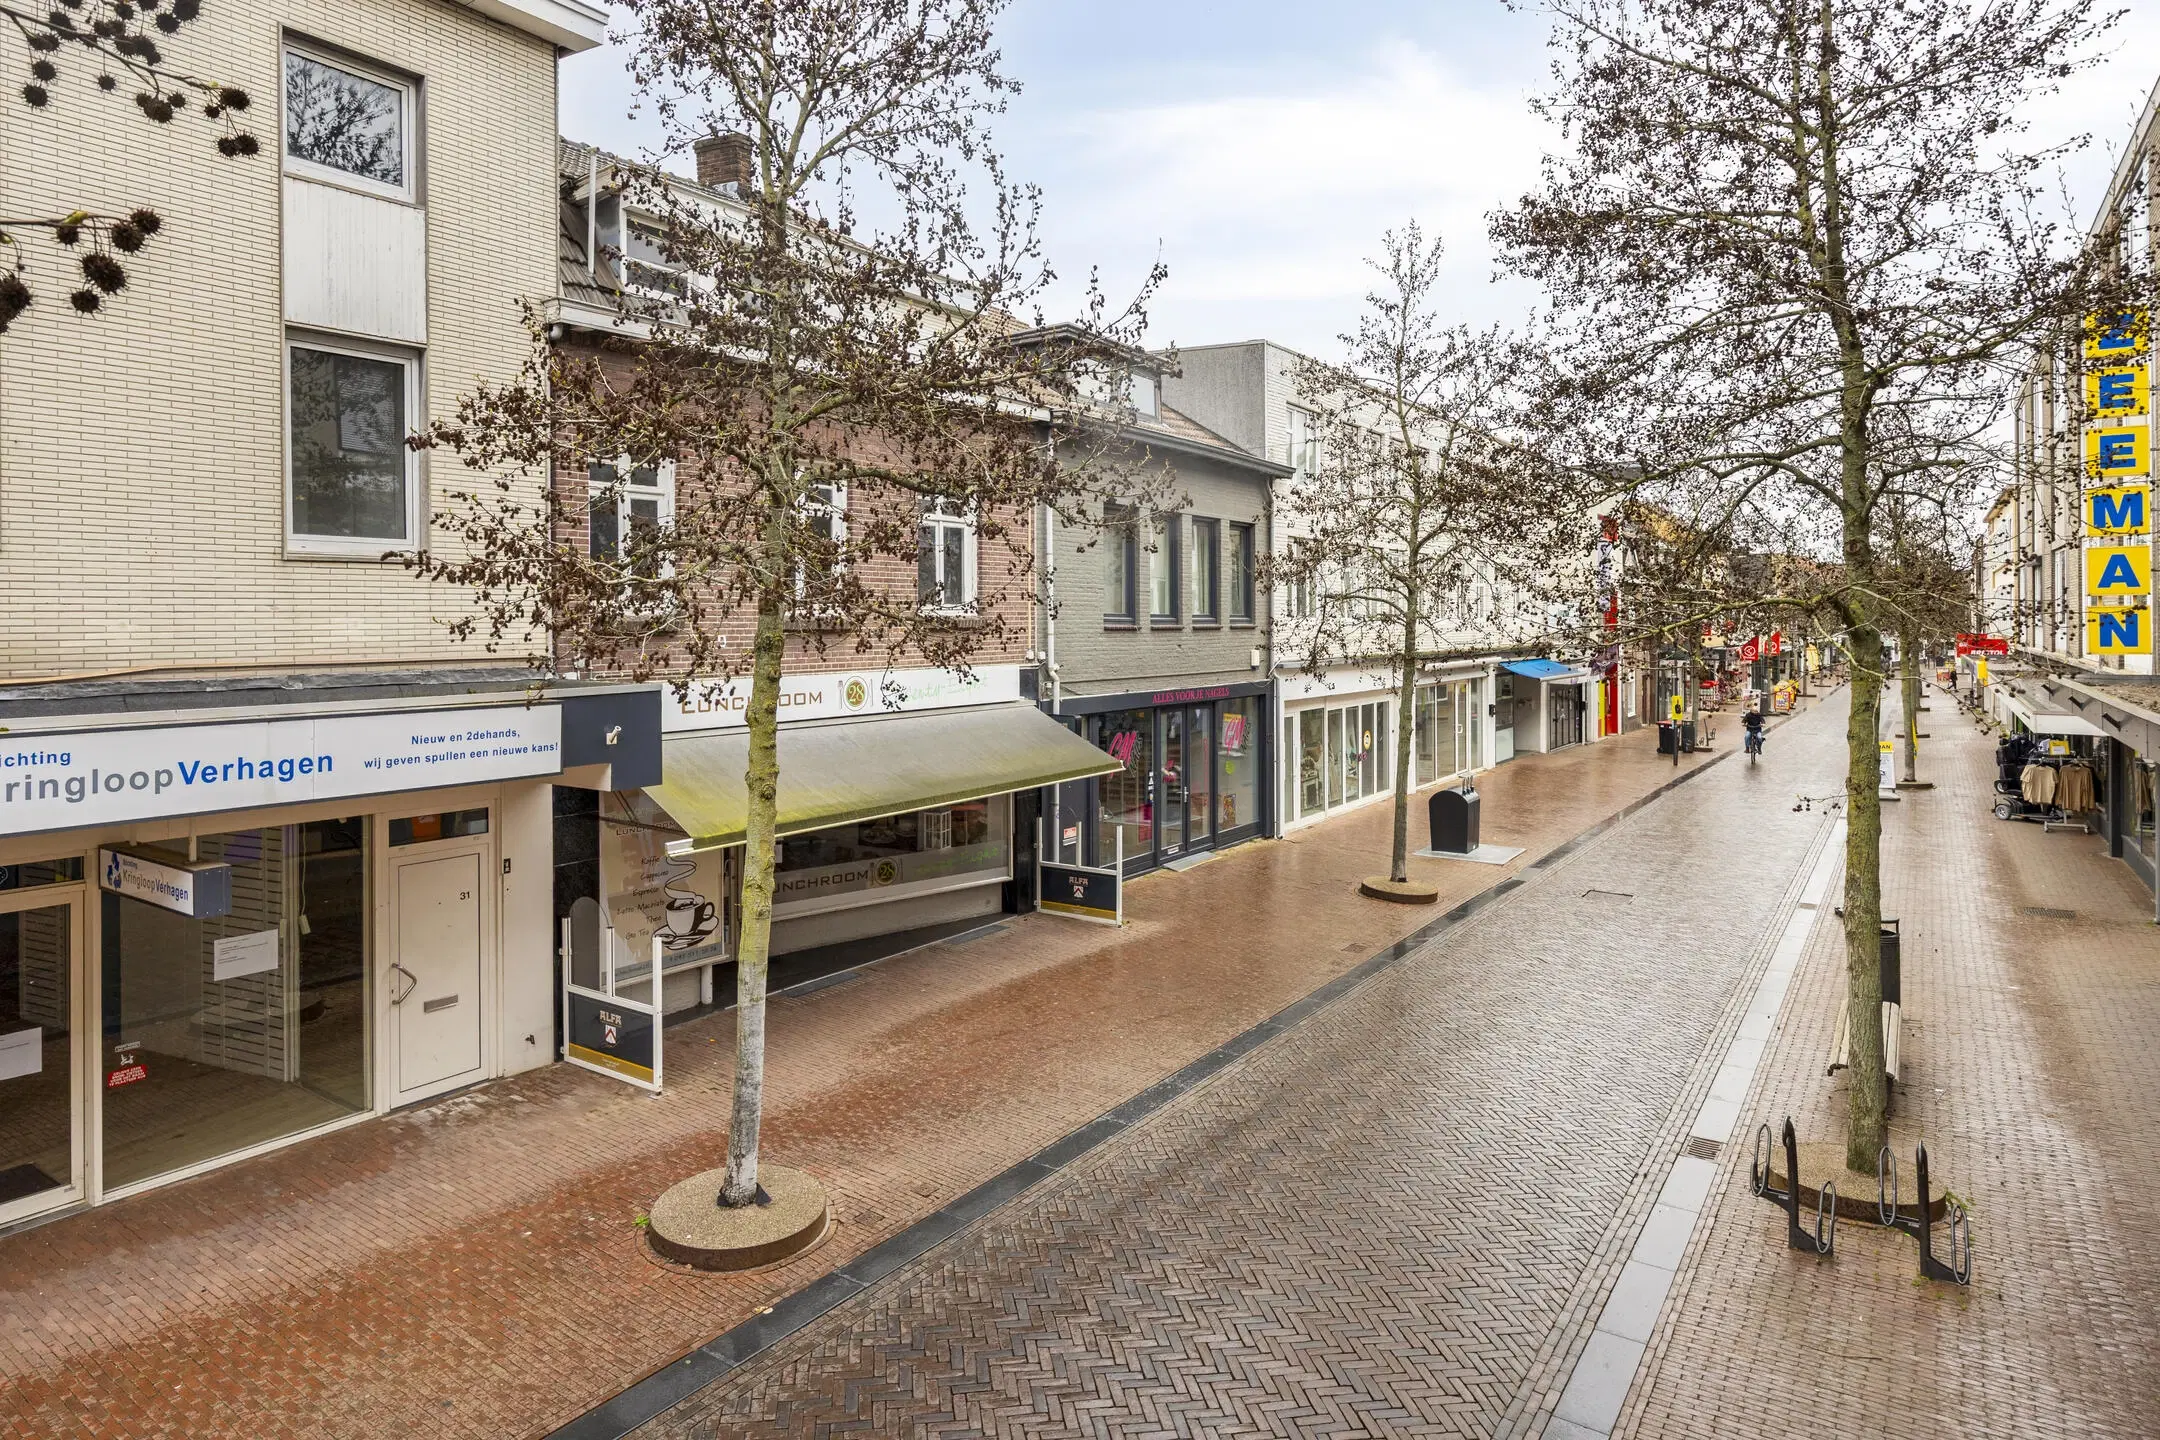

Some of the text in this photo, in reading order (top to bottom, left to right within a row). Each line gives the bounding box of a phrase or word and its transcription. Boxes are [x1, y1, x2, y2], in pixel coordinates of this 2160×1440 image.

[681, 691, 822, 714] LUNCOOM
[849, 685, 865, 702] 28
[1152, 692, 1174, 703] ALLES
[1175, 690, 1195, 700] VOOR
[1205, 687, 1230, 698] NAGELS
[411, 728, 521, 745] Nieuw en 2dehands,
[363, 742, 559, 769] wij geven spullen een nieuwe kans!
[772, 869, 869, 894] UNCHROOM
[1068, 876, 1089, 886] ALFA
[460, 891, 471, 900] 31
[599, 1010, 622, 1025] ALFA
